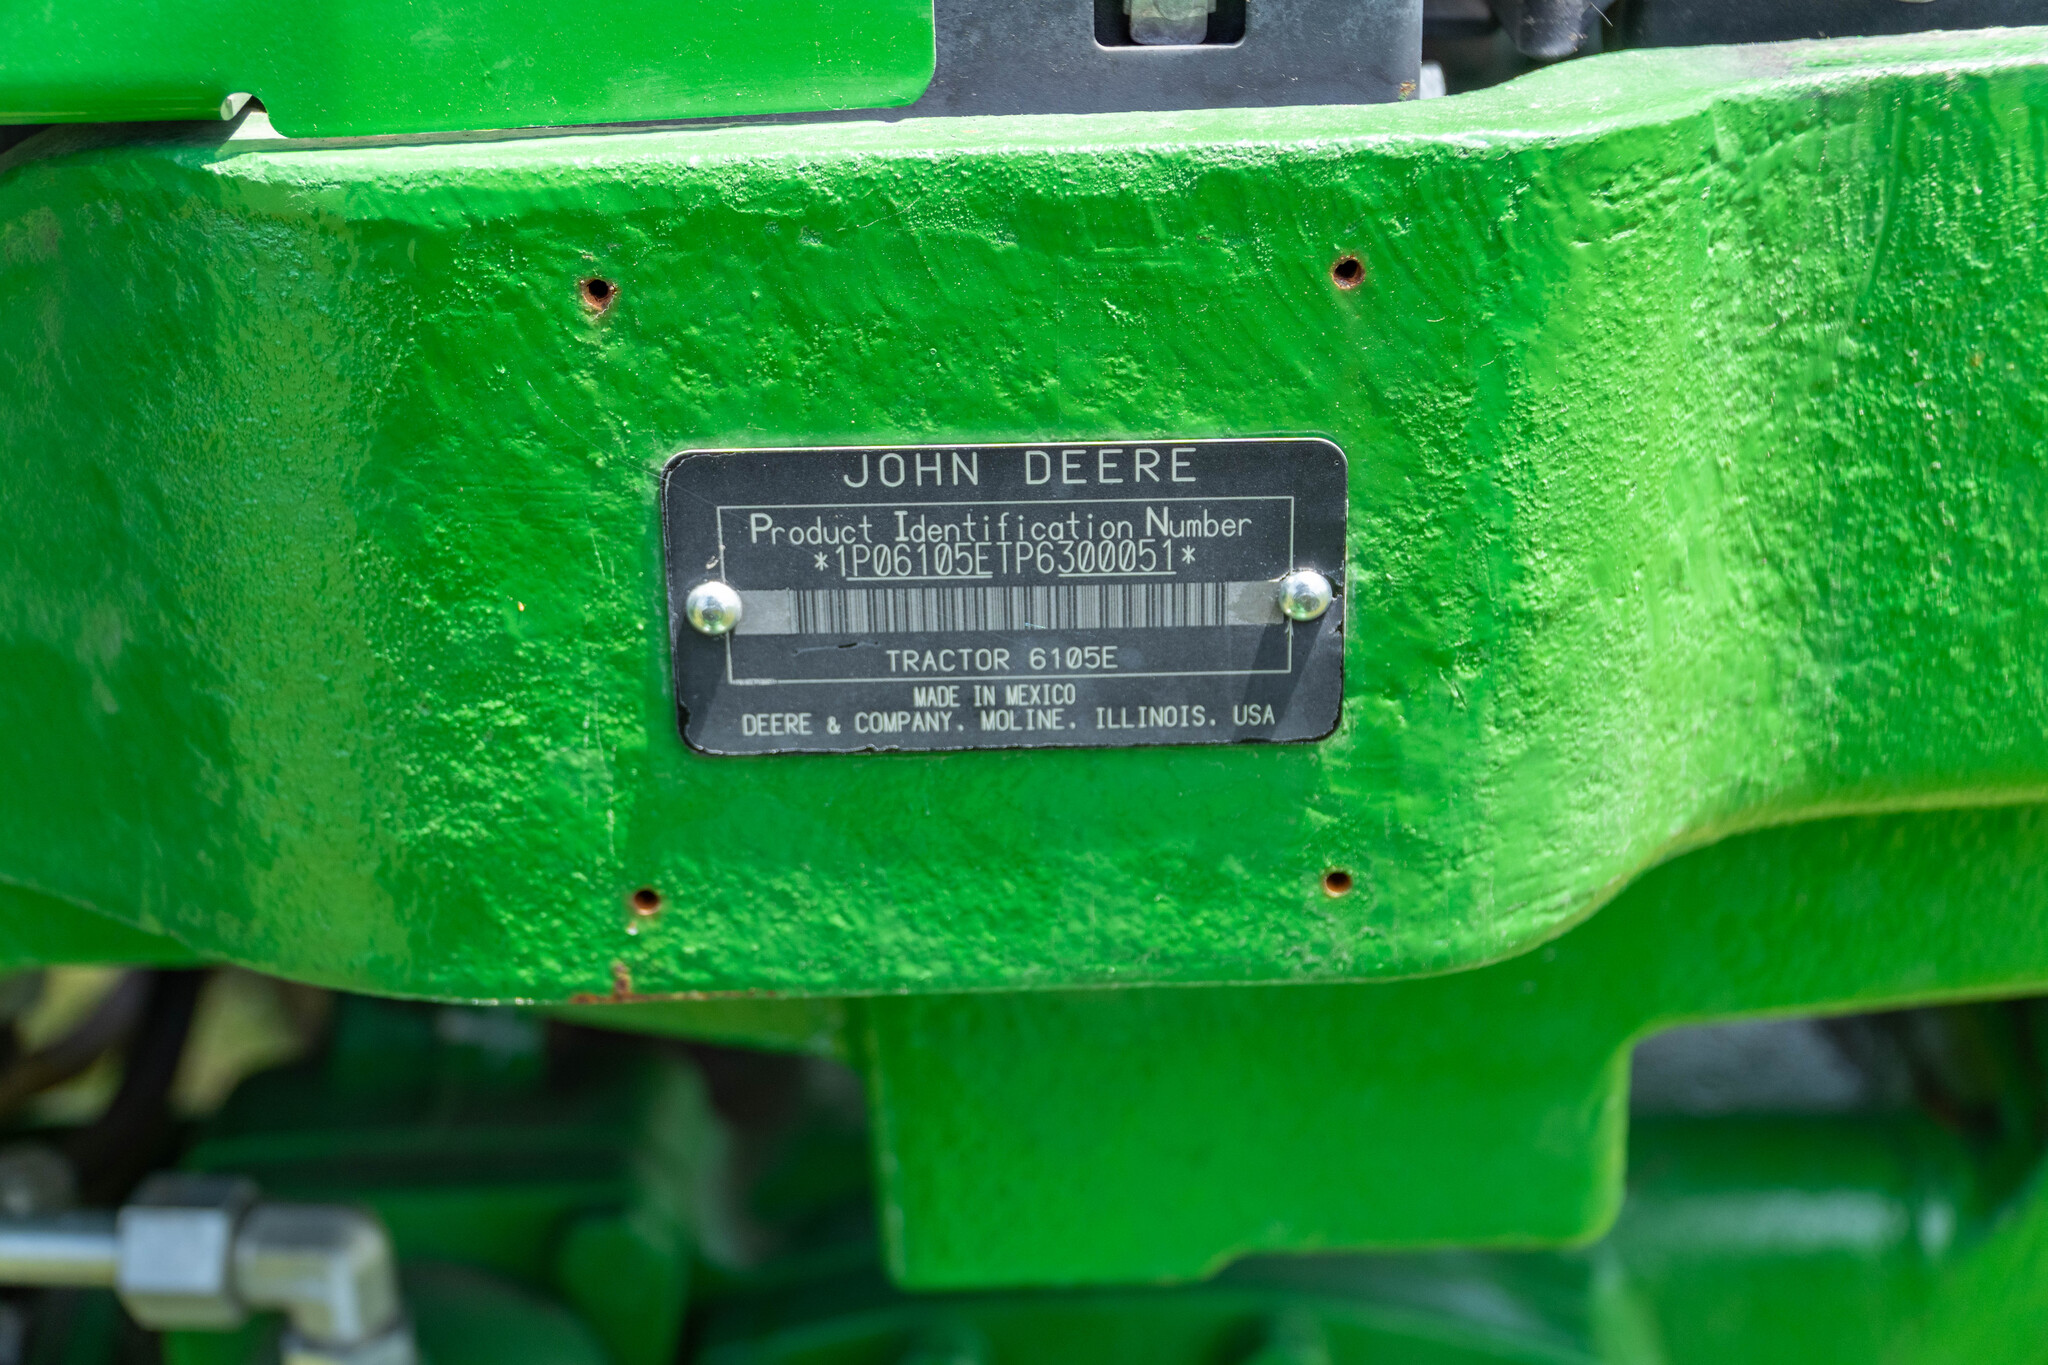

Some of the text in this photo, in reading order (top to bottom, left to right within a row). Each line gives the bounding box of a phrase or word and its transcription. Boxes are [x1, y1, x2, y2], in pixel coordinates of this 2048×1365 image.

[843, 448, 1197, 488] JOHN DEERE
[750, 506, 1252, 545] Product Identification Number
[886, 646, 1119, 672] TRACTOR 6105E
[913, 683, 1076, 707] MADE IN MEXICO
[741, 713, 812, 736] DEERE
[826, 716, 841, 735] &
[1233, 704, 1276, 726] USA
